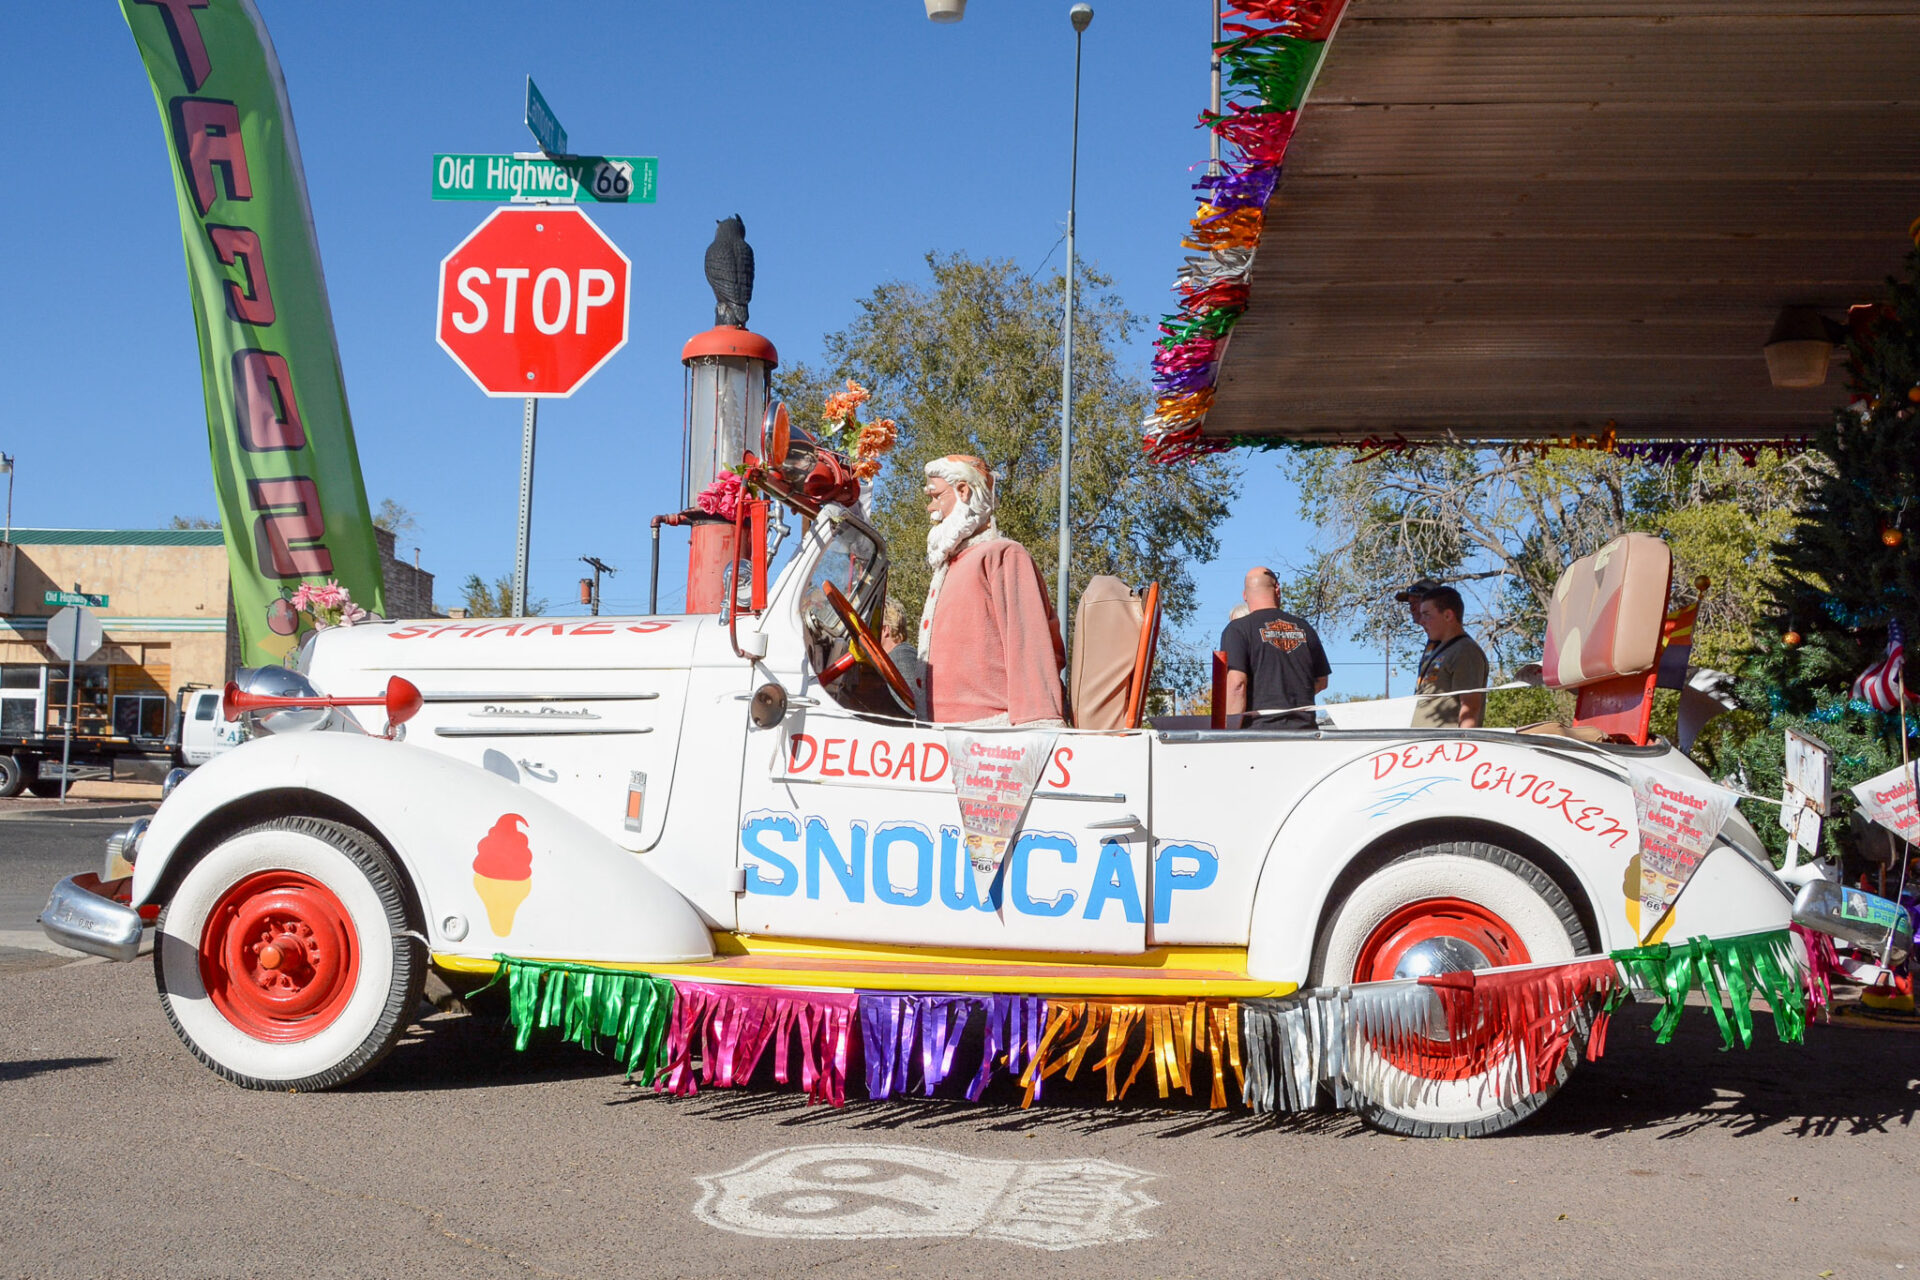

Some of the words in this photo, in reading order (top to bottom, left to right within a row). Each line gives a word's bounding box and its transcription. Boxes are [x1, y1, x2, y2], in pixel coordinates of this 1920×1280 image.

[438, 156, 475, 190] Old
[487, 157, 583, 199] Highway
[596, 165, 630, 195] 66
[452, 267, 615, 335] STOP
[45, 591, 58, 602] Old
[60, 592, 87, 606] Highway
[388, 618, 682, 640] SHAKES
[970, 743, 1026, 761] Cruisin'
[1369, 742, 1479, 780] DEAD
[966, 774, 993, 788] 66th
[996, 779, 1023, 792] year
[1470, 762, 1629, 849] CHICKEN
[1652, 783, 1708, 811] Cruisin'
[964, 803, 1000, 818] Route
[1003, 808, 1018, 820] 66
[1648, 809, 1675, 829] 66th
[1676, 821, 1703, 839] year
[1680, 809, 1695, 820] our
[1643, 837, 1679, 861] Route
[1679, 853, 1695, 867] 66
[977, 862, 991, 872] 66
[1646, 899, 1661, 911] 66
[748, 1157, 960, 1220] 66
